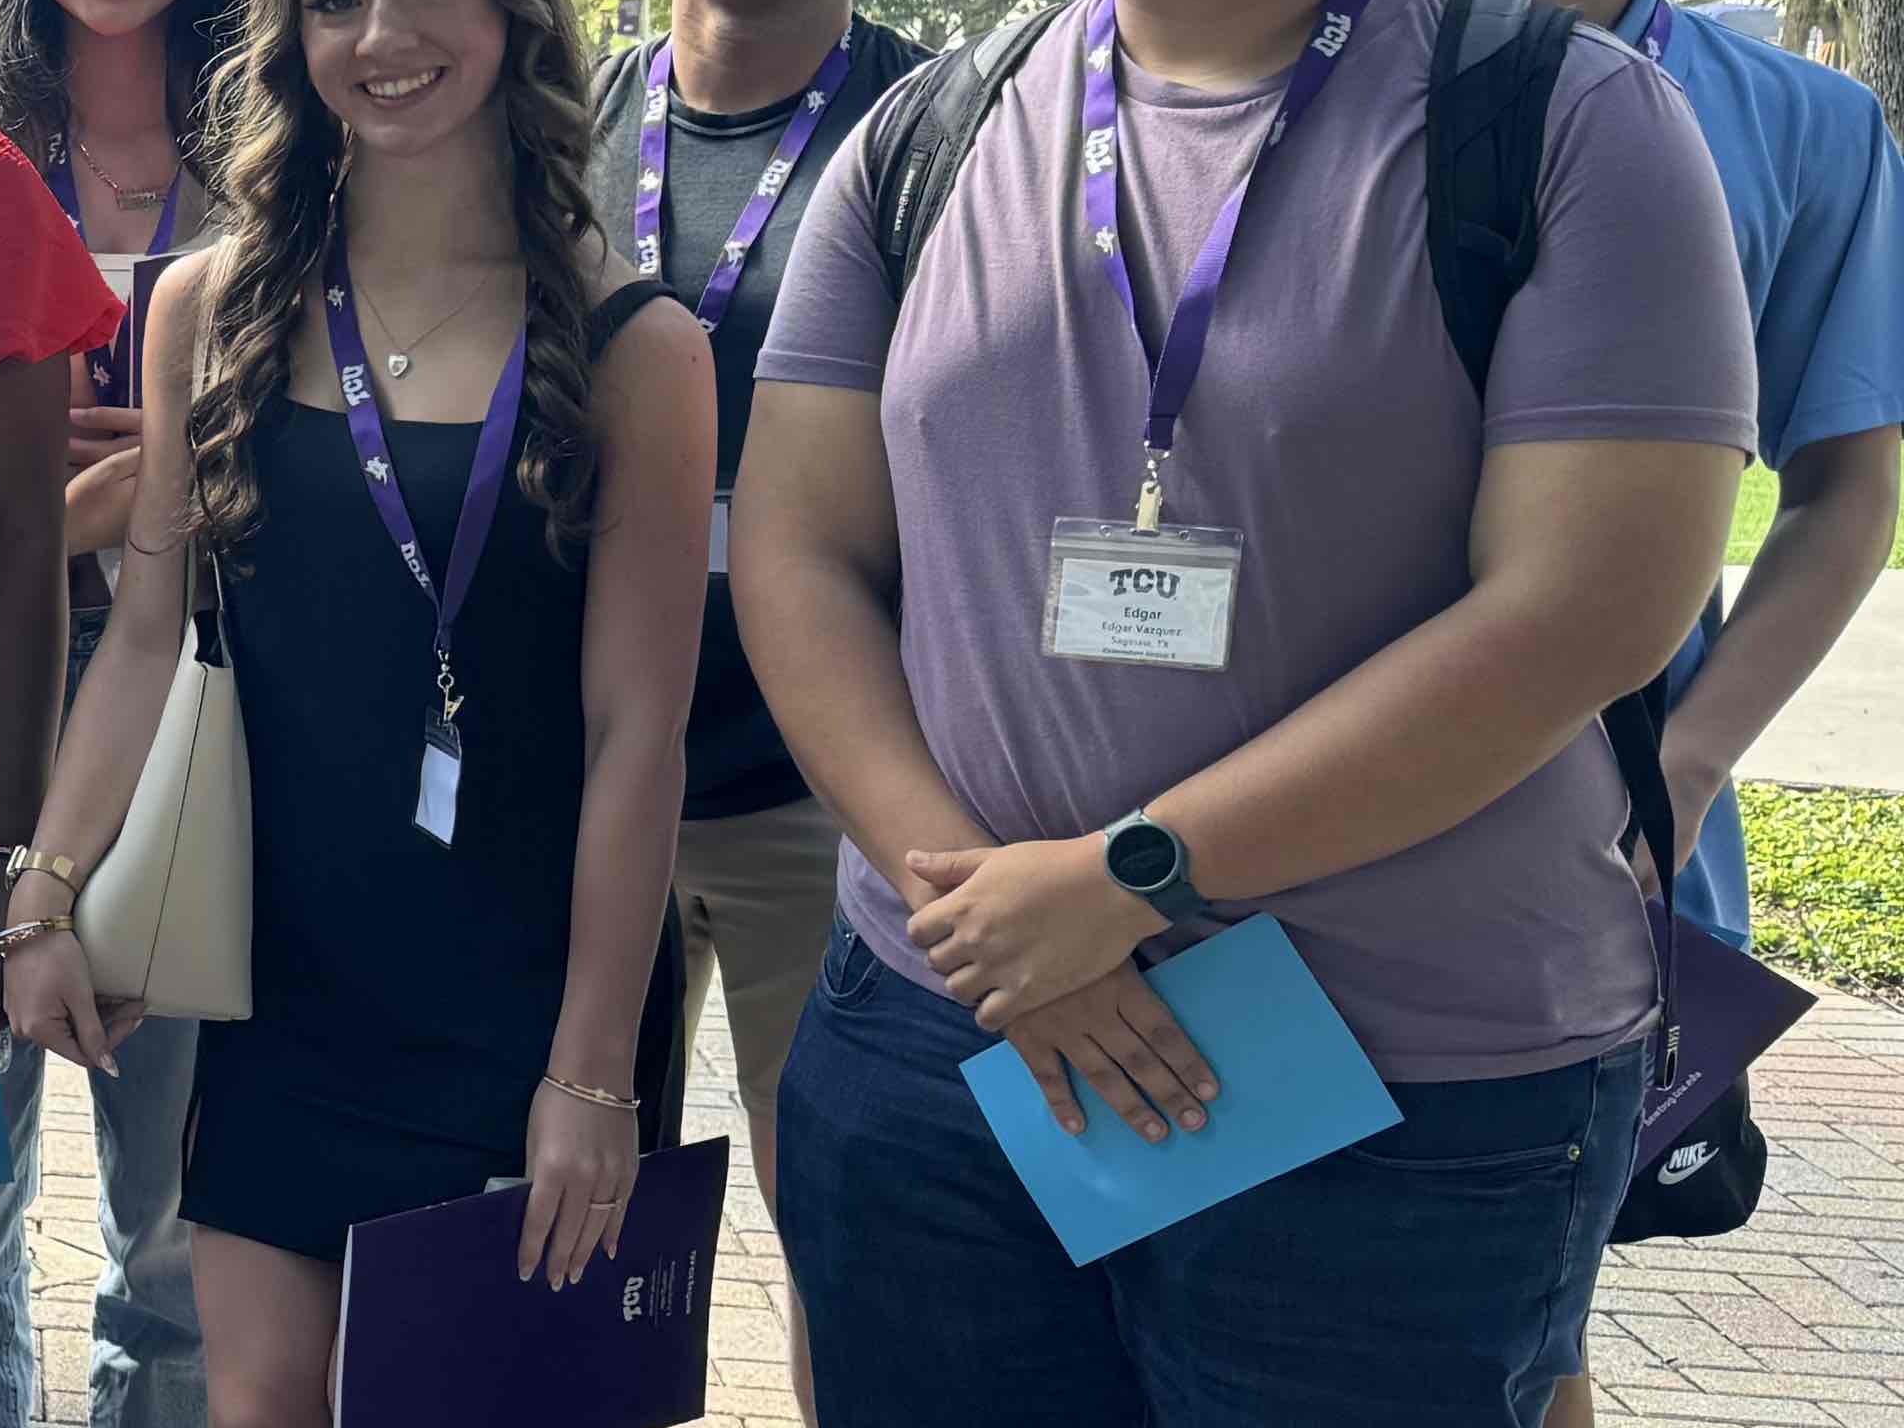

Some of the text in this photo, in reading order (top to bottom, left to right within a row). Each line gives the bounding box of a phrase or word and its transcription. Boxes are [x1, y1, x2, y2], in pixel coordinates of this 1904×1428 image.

[1312, 12, 1352, 58] TCU
[1085, 126, 1114, 174] TCU
[758, 158, 793, 197] TCU
[638, 234, 658, 274] TCU
[342, 364, 370, 407] TCU
[400, 540, 430, 589] TCU
[1109, 568, 1181, 599] TCU
[1102, 621, 1133, 634] Edgar
[1124, 607, 1162, 621] Edgar
[1668, 1140, 1708, 1170] NIKE
[623, 1276, 644, 1322] TCU
